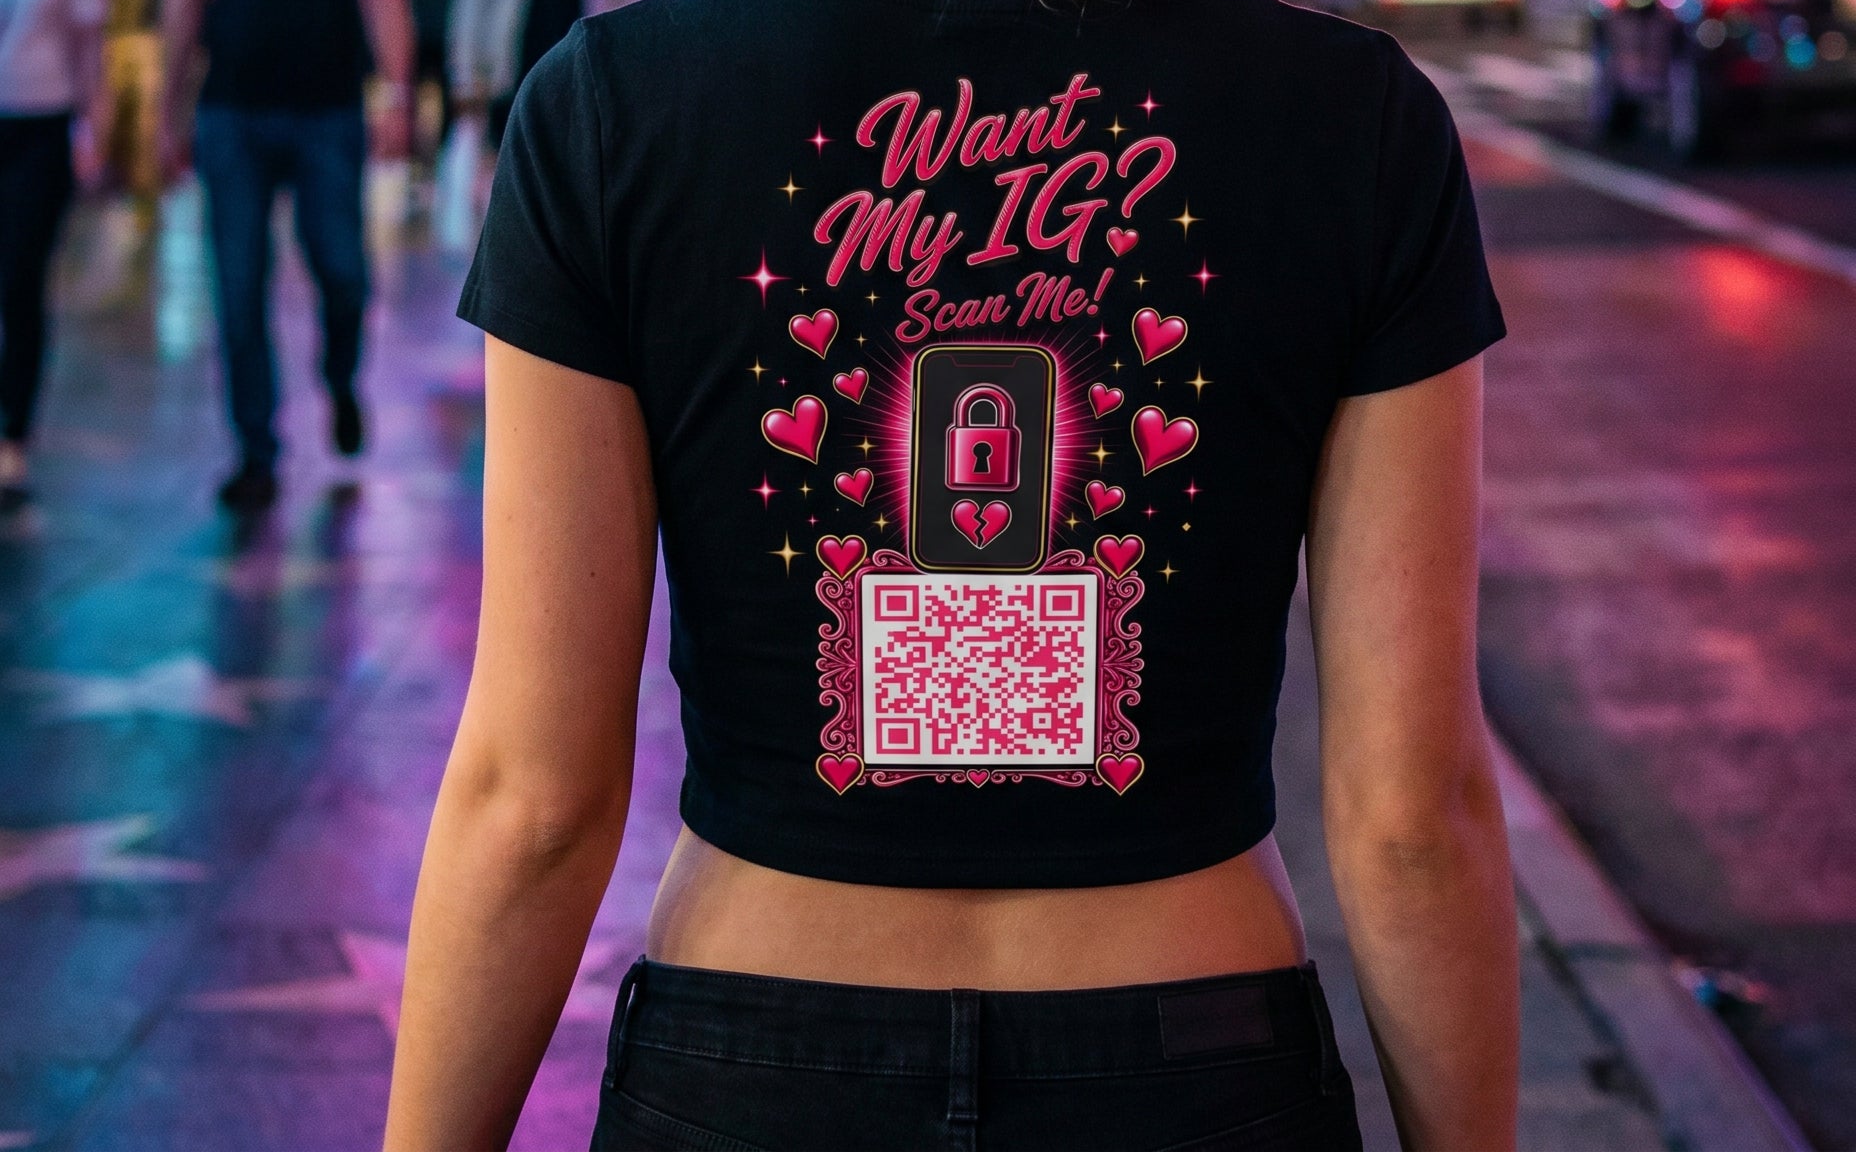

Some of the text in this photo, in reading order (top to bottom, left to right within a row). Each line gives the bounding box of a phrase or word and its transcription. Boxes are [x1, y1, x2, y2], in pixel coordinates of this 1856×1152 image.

[855, 73, 1101, 189] Want
[813, 136, 1177, 287] My IG?
[896, 267, 1115, 343] Scan Me!
